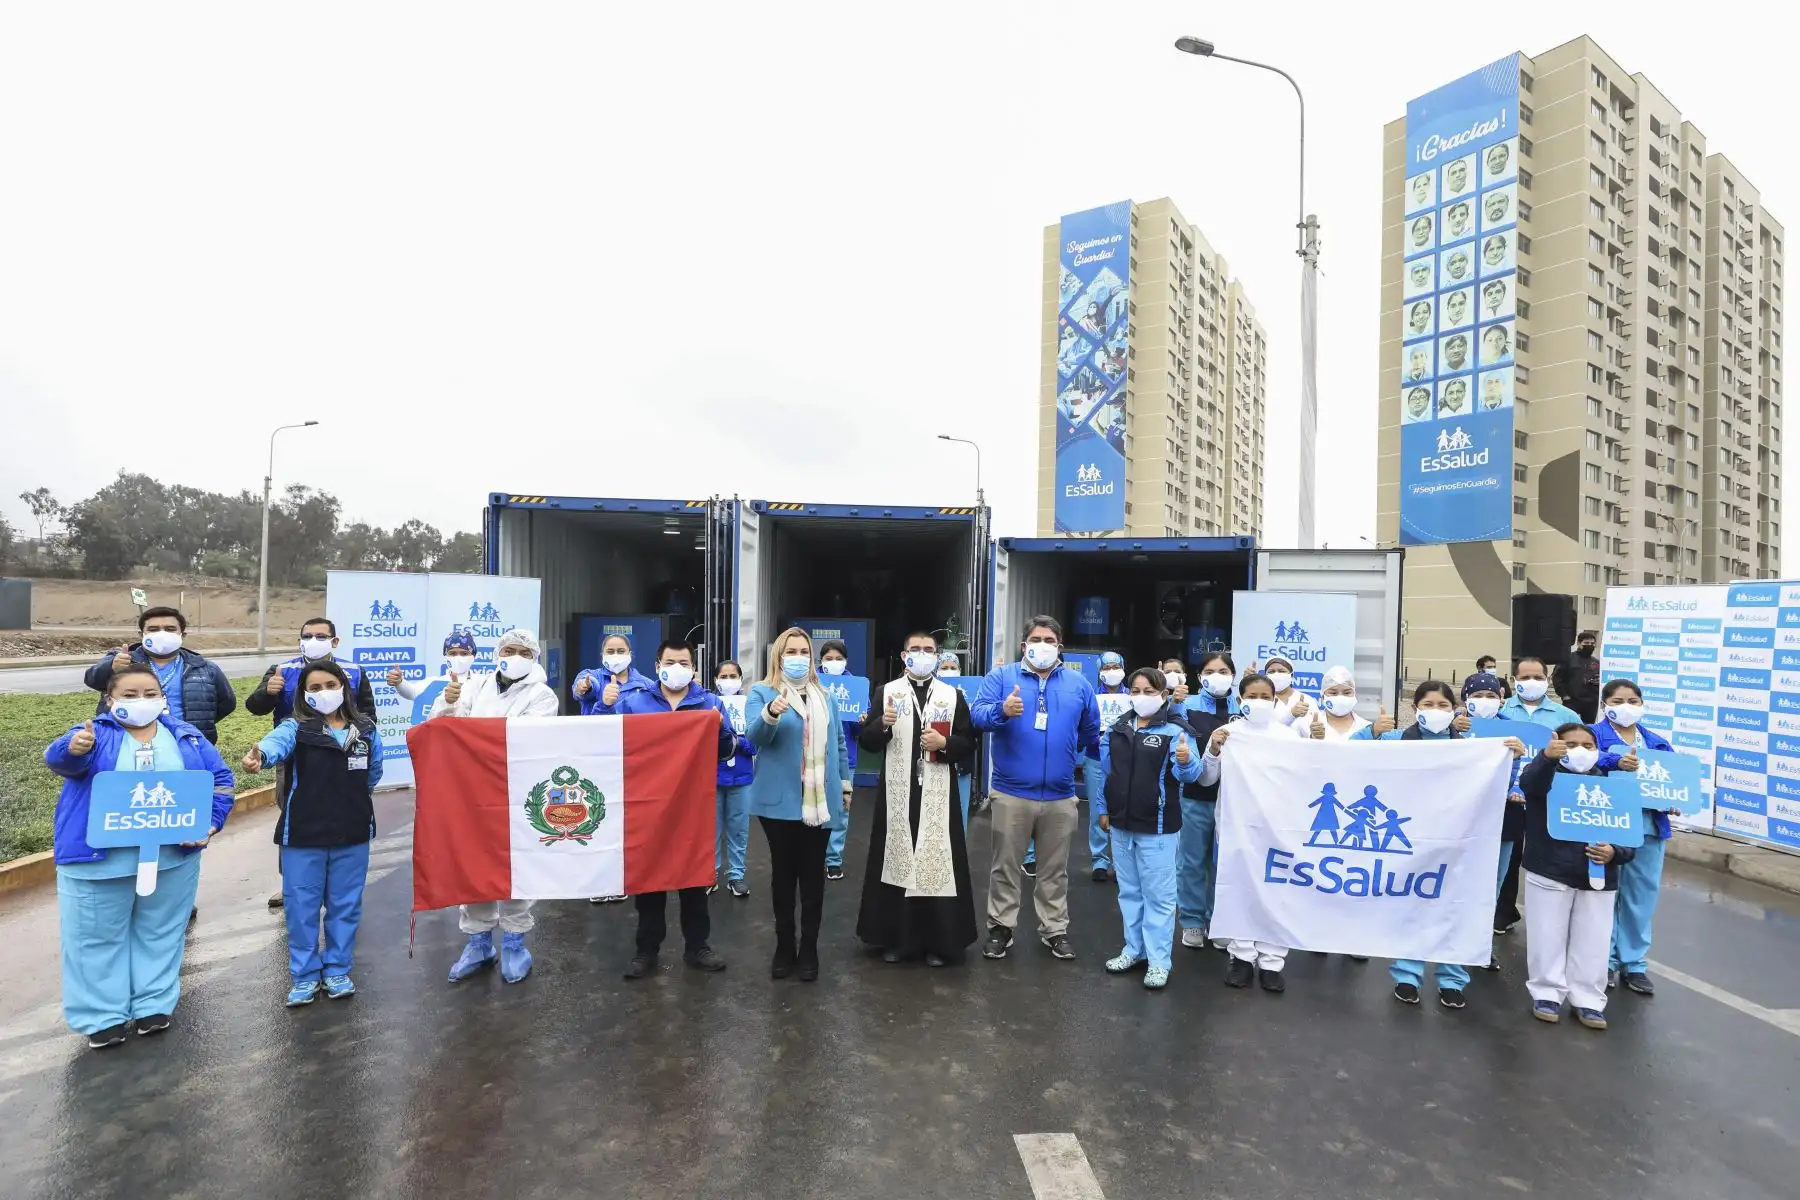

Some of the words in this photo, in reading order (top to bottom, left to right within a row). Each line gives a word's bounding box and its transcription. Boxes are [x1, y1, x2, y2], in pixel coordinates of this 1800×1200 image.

[1110, 233, 1124, 243] en
[1073, 247, 1116, 267] Guardia!
[1421, 447, 1489, 473] EsSalud
[1065, 480, 1114, 497] EsSalud
[1413, 477, 1498, 494] #SeguimosEnGuardia
[1652, 600, 1698, 611] EsSalud
[353, 622, 417, 637] EsSalud
[359, 651, 411, 661] PLANTA
[1292, 676, 1319, 688] NTA
[376, 696, 400, 707] URA
[838, 699, 860, 713] alud
[1640, 782, 1689, 802] Salud
[104, 808, 196, 831] EsSalud
[1560, 807, 1630, 830] EsSalud
[1264, 847, 1448, 899] EsSalud
